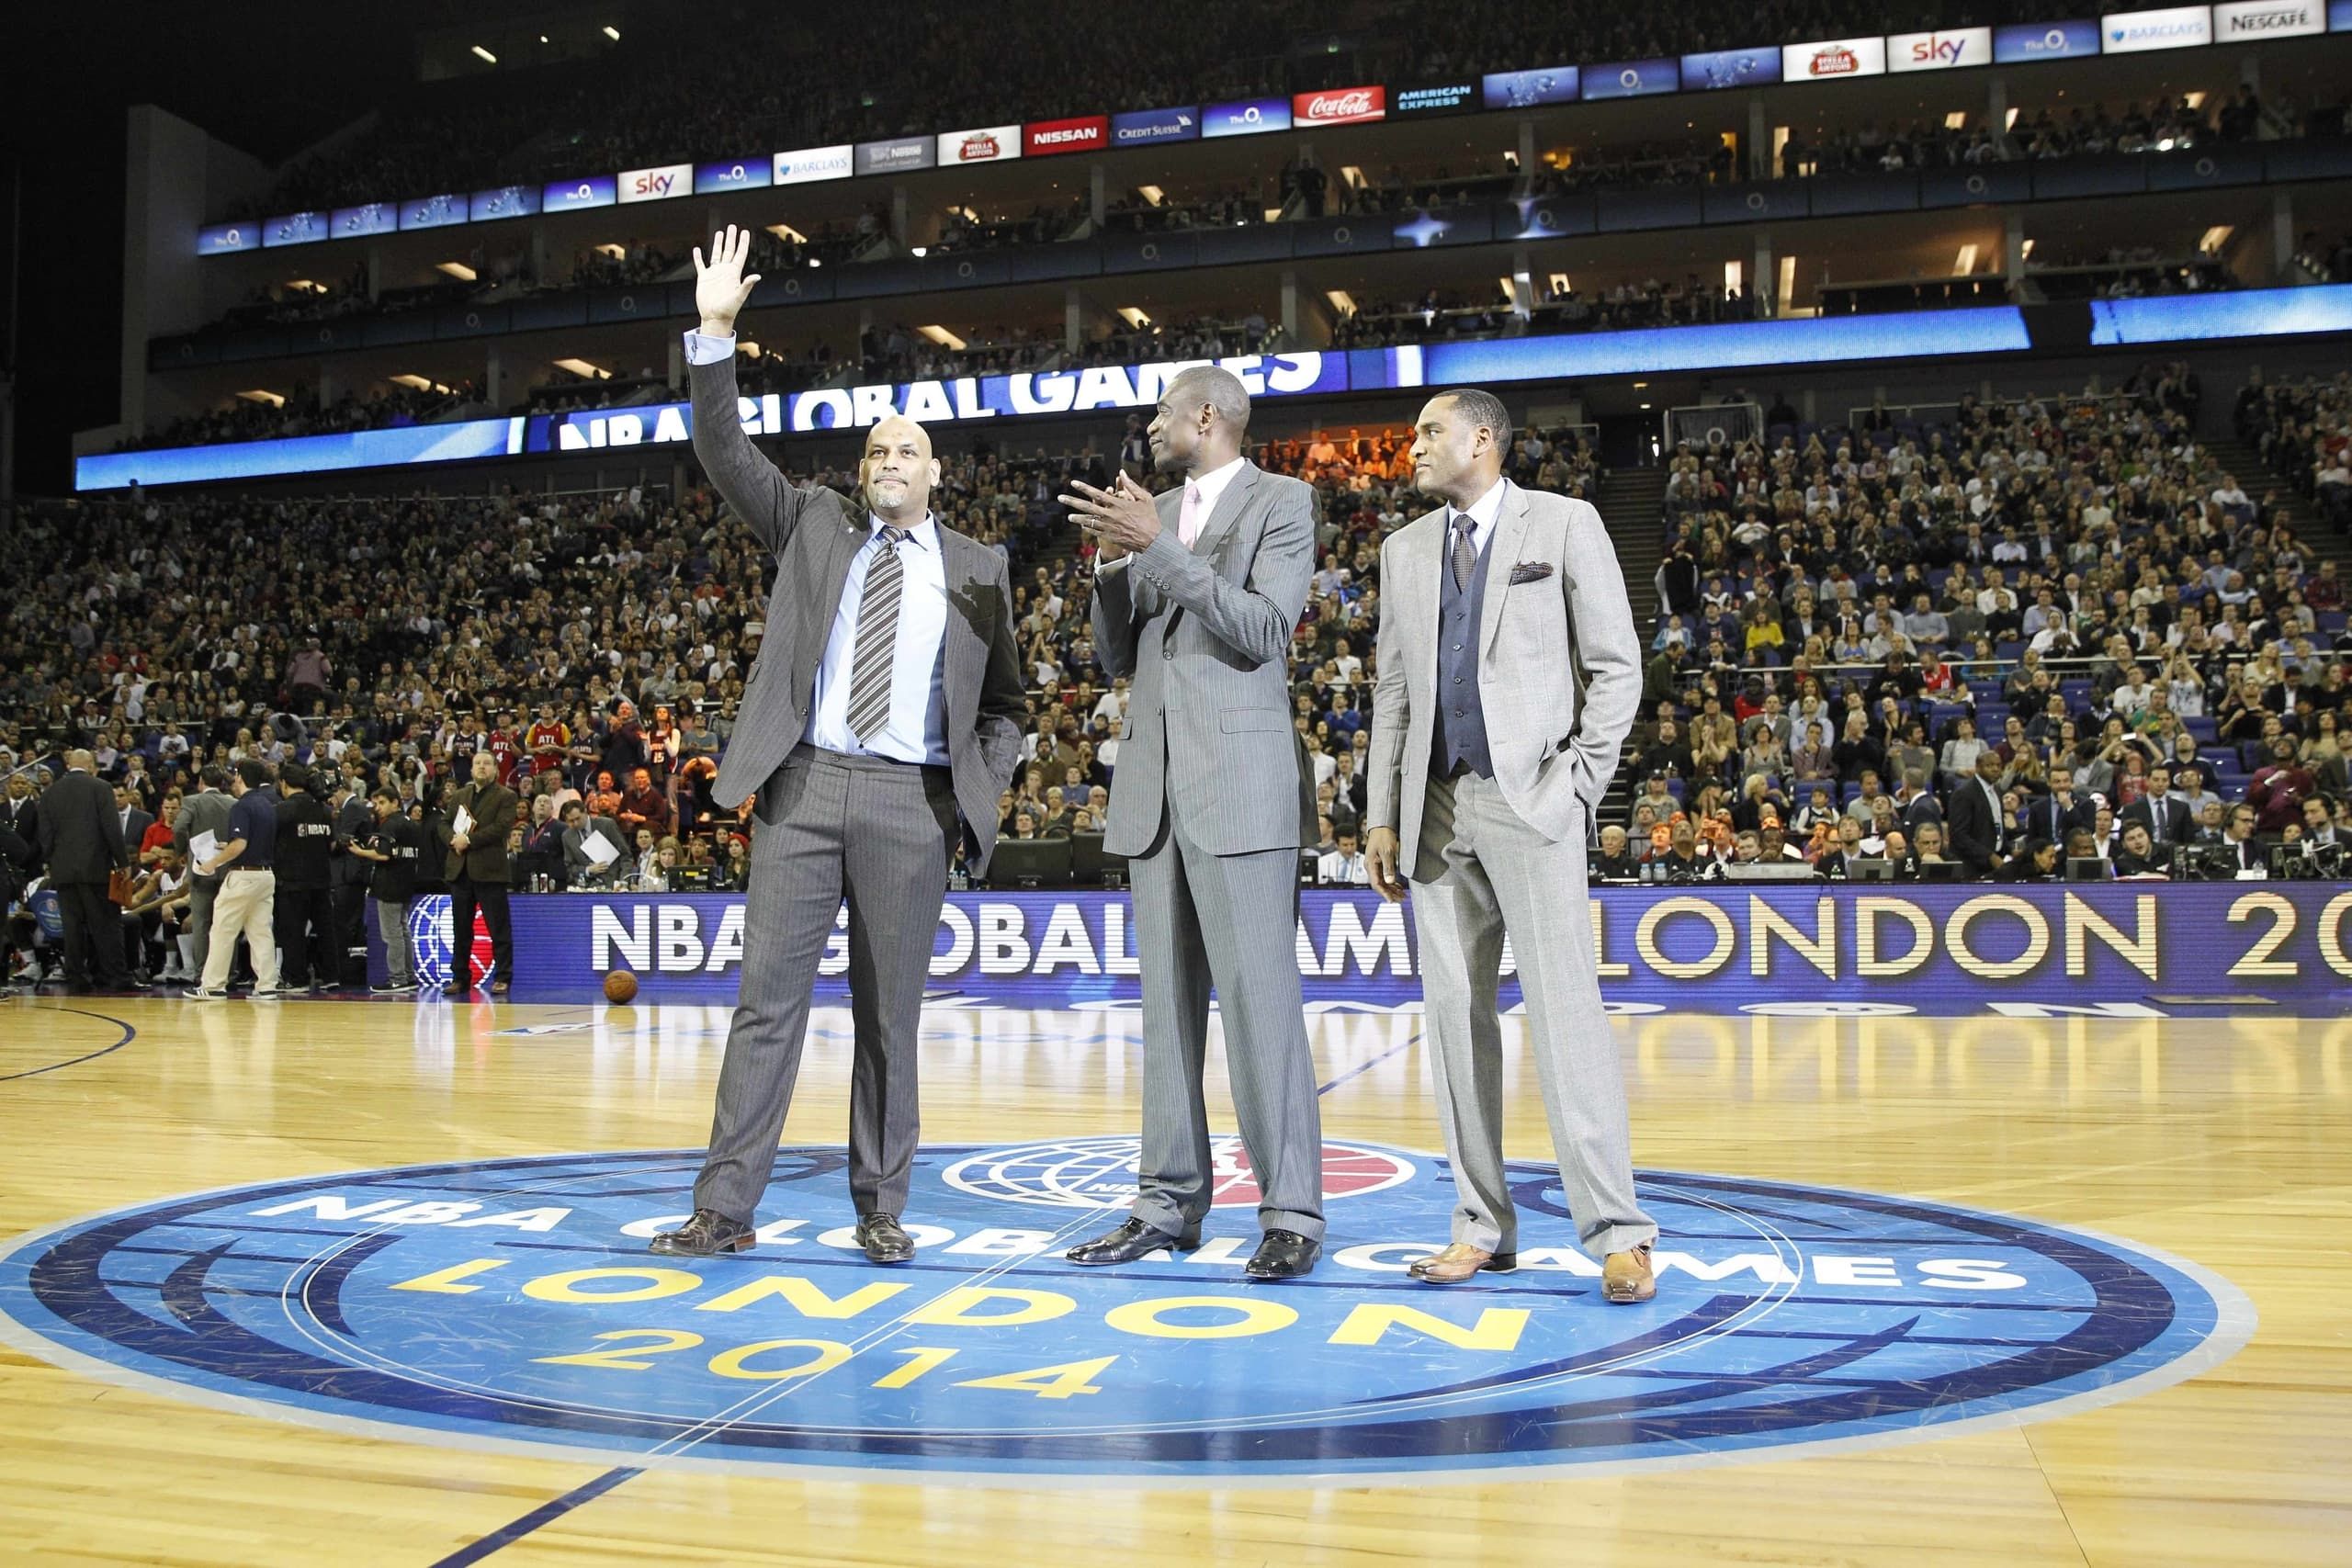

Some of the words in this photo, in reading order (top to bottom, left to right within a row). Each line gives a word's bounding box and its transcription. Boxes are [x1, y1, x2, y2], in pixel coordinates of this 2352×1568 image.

[2129, 22, 2204, 40] BARCLAYS
[1913, 36, 1965, 65] sky
[1397, 85, 1471, 101] AMERICAN
[1398, 96, 1460, 110] EXPRESS
[1034, 128, 1098, 145] NISSAN
[793, 157, 847, 174] BARCLAYS
[636, 172, 675, 196] sky
[591, 904, 746, 972] NBA
[815, 903, 1140, 976] OBAL
[1591, 892, 2157, 981] LONDON
[1084, 1183, 1139, 1193] NB
[246, 1196, 573, 1232] NBA
[1332, 1242, 2028, 1290] GAMES
[388, 1258, 1532, 1352] LONDON
[531, 1328, 1119, 1399] 2014
